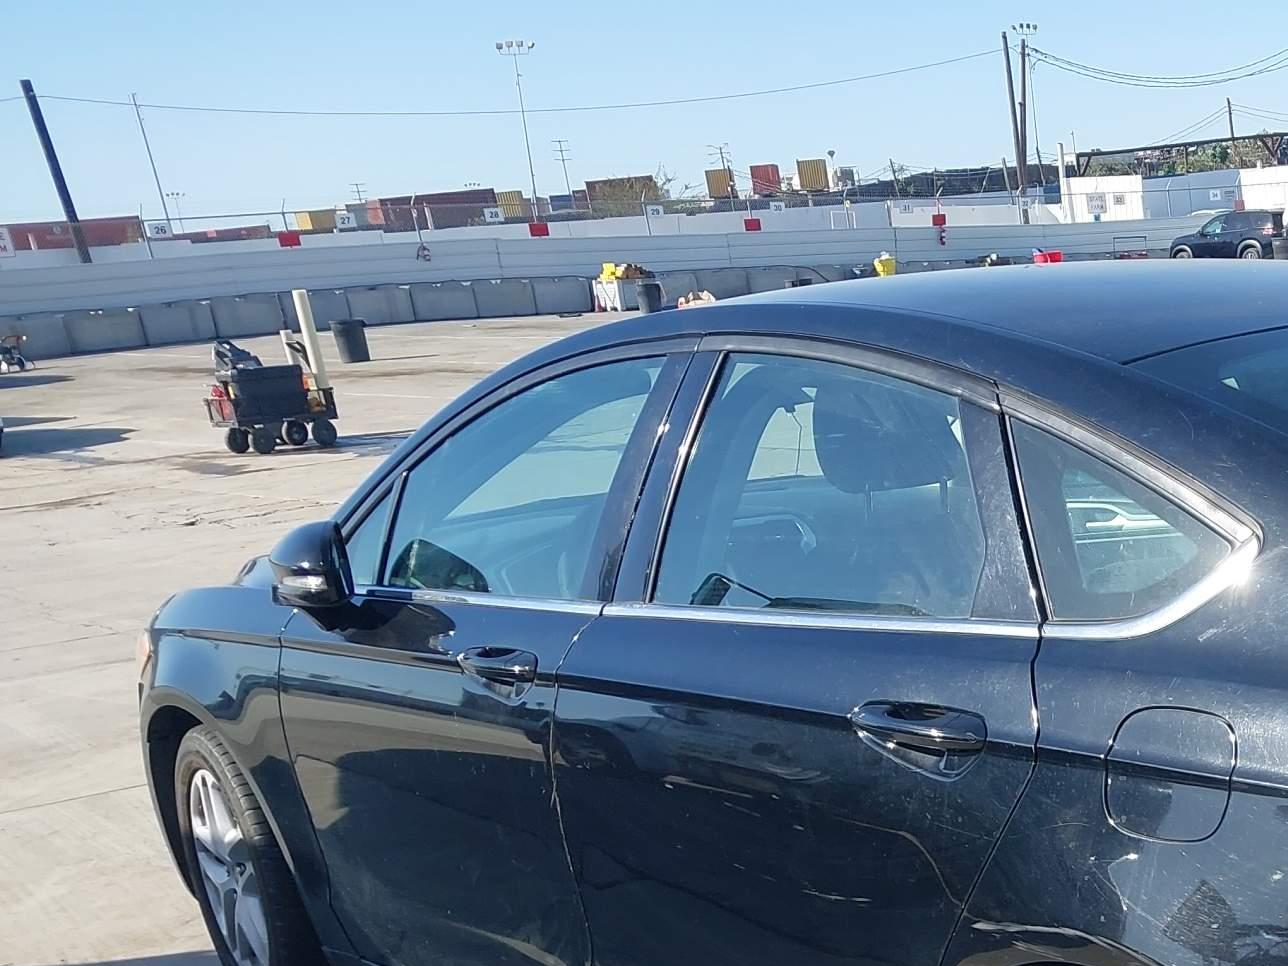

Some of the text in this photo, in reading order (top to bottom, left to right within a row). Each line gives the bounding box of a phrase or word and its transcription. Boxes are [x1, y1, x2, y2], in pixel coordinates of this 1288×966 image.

[489, 211, 499, 219] 28
[650, 208, 660, 216] 29
[340, 217, 350, 225] 27
[154, 225, 167, 235] 26
